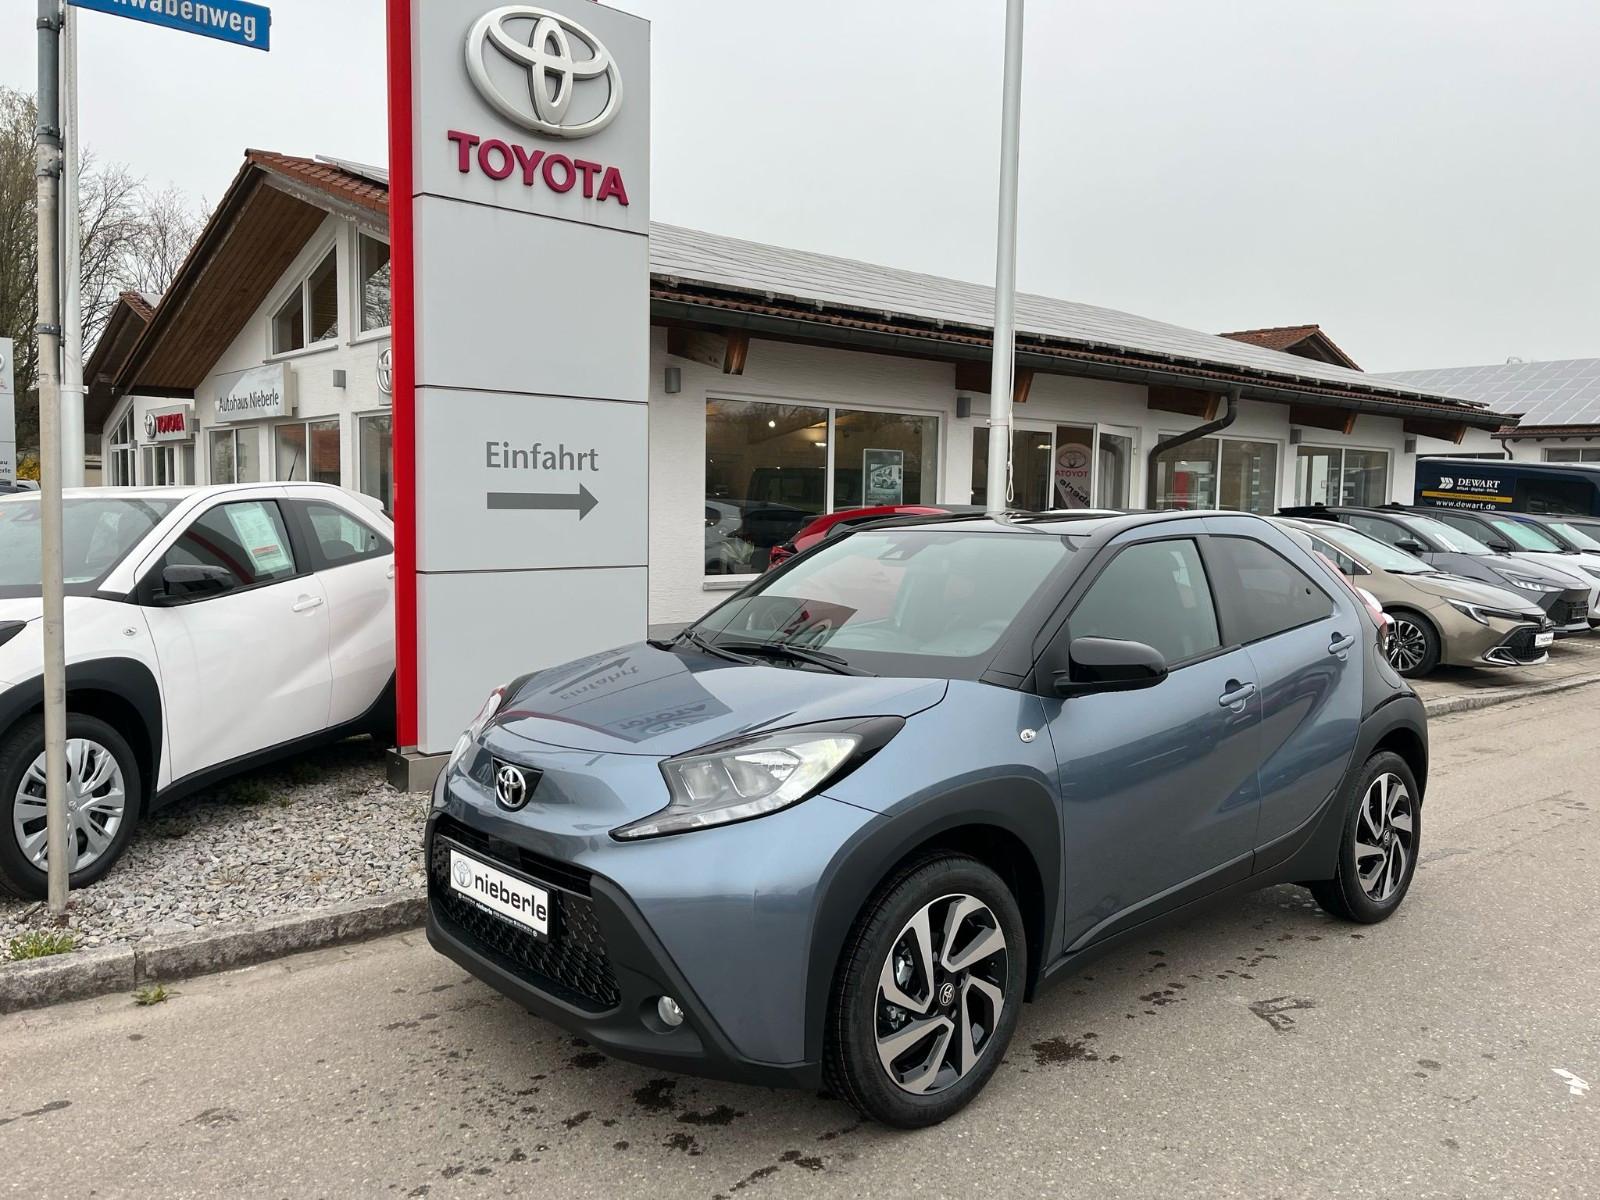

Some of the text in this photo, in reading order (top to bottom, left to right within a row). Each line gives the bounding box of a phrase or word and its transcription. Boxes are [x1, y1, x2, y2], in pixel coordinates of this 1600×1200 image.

[113, 0, 256, 42] wabenweg
[448, 130, 629, 206] TOYOTA
[218, 388, 279, 413] Autohaus Nieberle
[486, 441, 599, 471] Einfahrt
[1458, 479, 1500, 488] DEWART
[1436, 501, 1496, 510] www.dewart.de
[475, 873, 547, 922] nieberle
